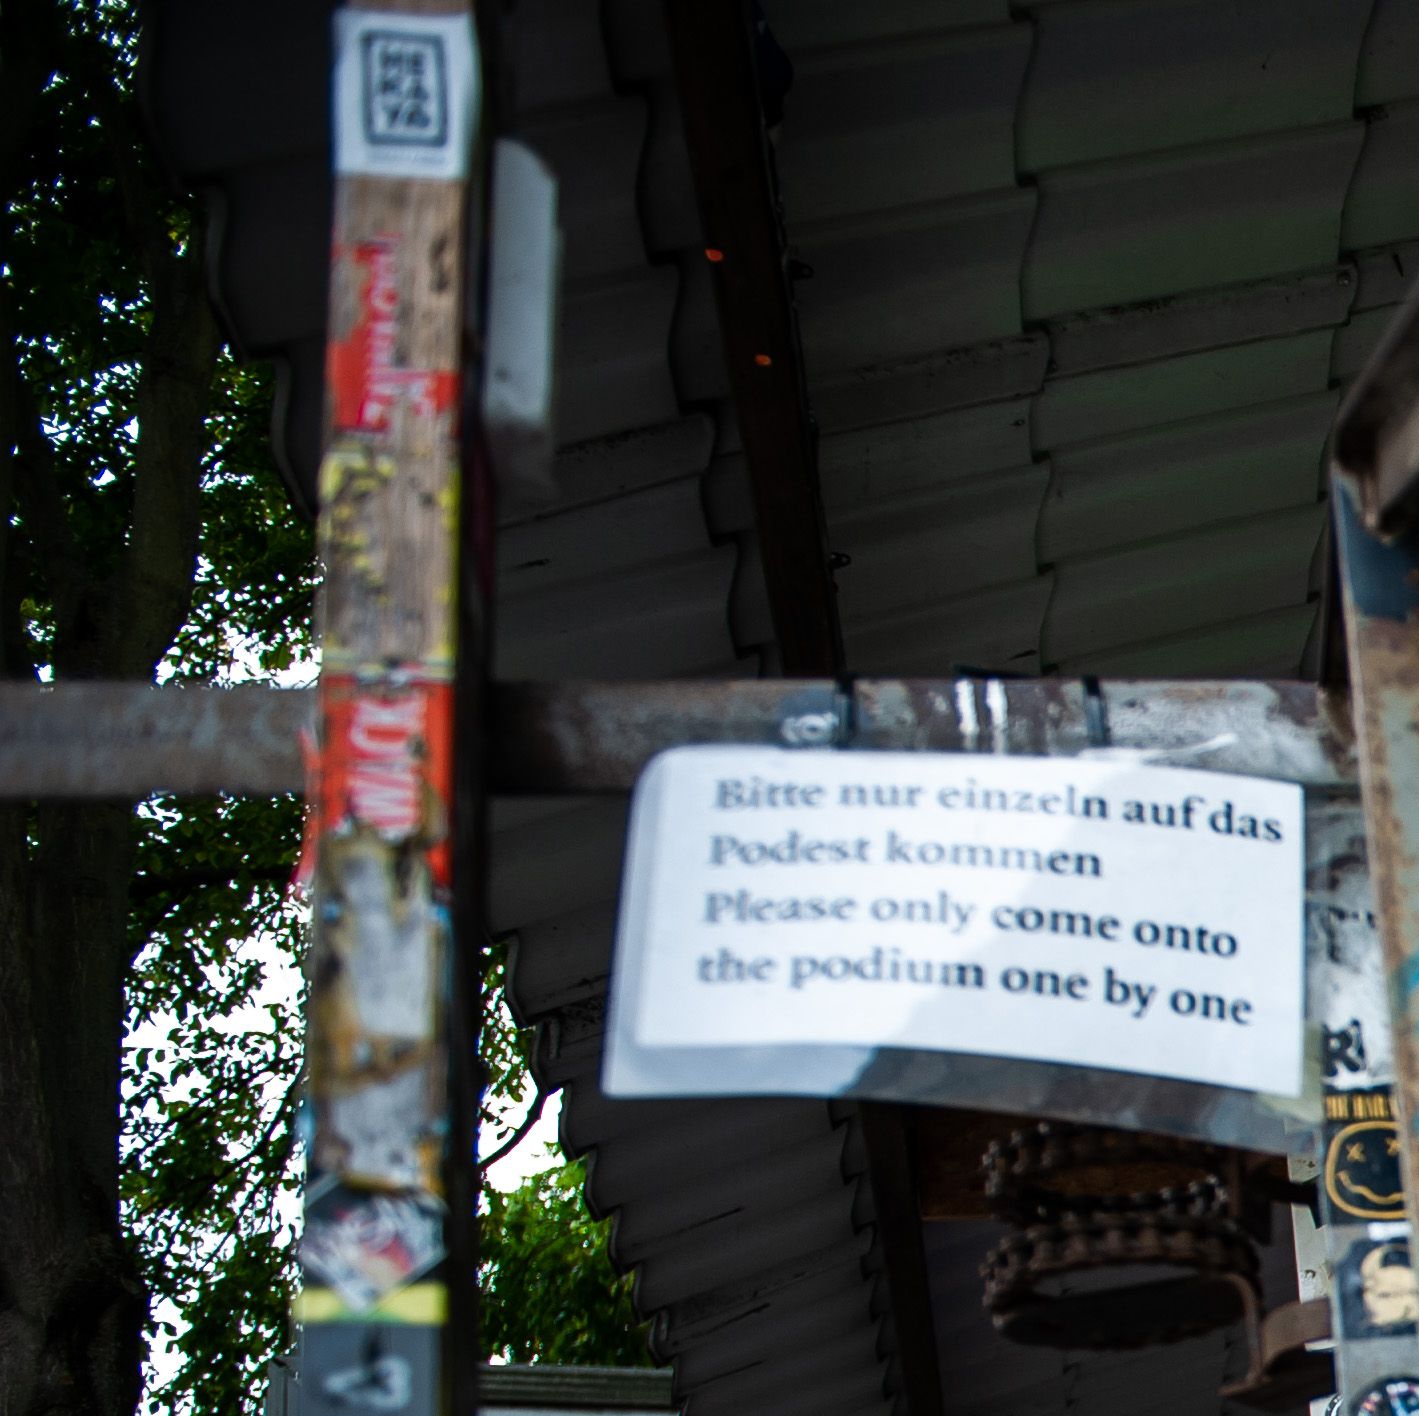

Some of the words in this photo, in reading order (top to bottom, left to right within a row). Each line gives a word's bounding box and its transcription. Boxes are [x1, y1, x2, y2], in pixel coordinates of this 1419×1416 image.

[714, 776, 826, 811] Bitte
[839, 783, 923, 809] nur
[936, 783, 1110, 821] einzeln
[1121, 795, 1203, 830] auf
[1206, 798, 1285, 844] das
[708, 832, 871, 870] Podest
[884, 830, 1103, 878] kommen
[703, 889, 857, 925] Please
[869, 889, 979, 935] only
[991, 904, 1122, 942] come
[1132, 917, 1238, 958] onto
[699, 946, 777, 983] the
[788, 947, 985, 990] podium
[999, 964, 1090, 1000] one
[1103, 967, 1157, 1017] by
[1168, 988, 1254, 1027] one
